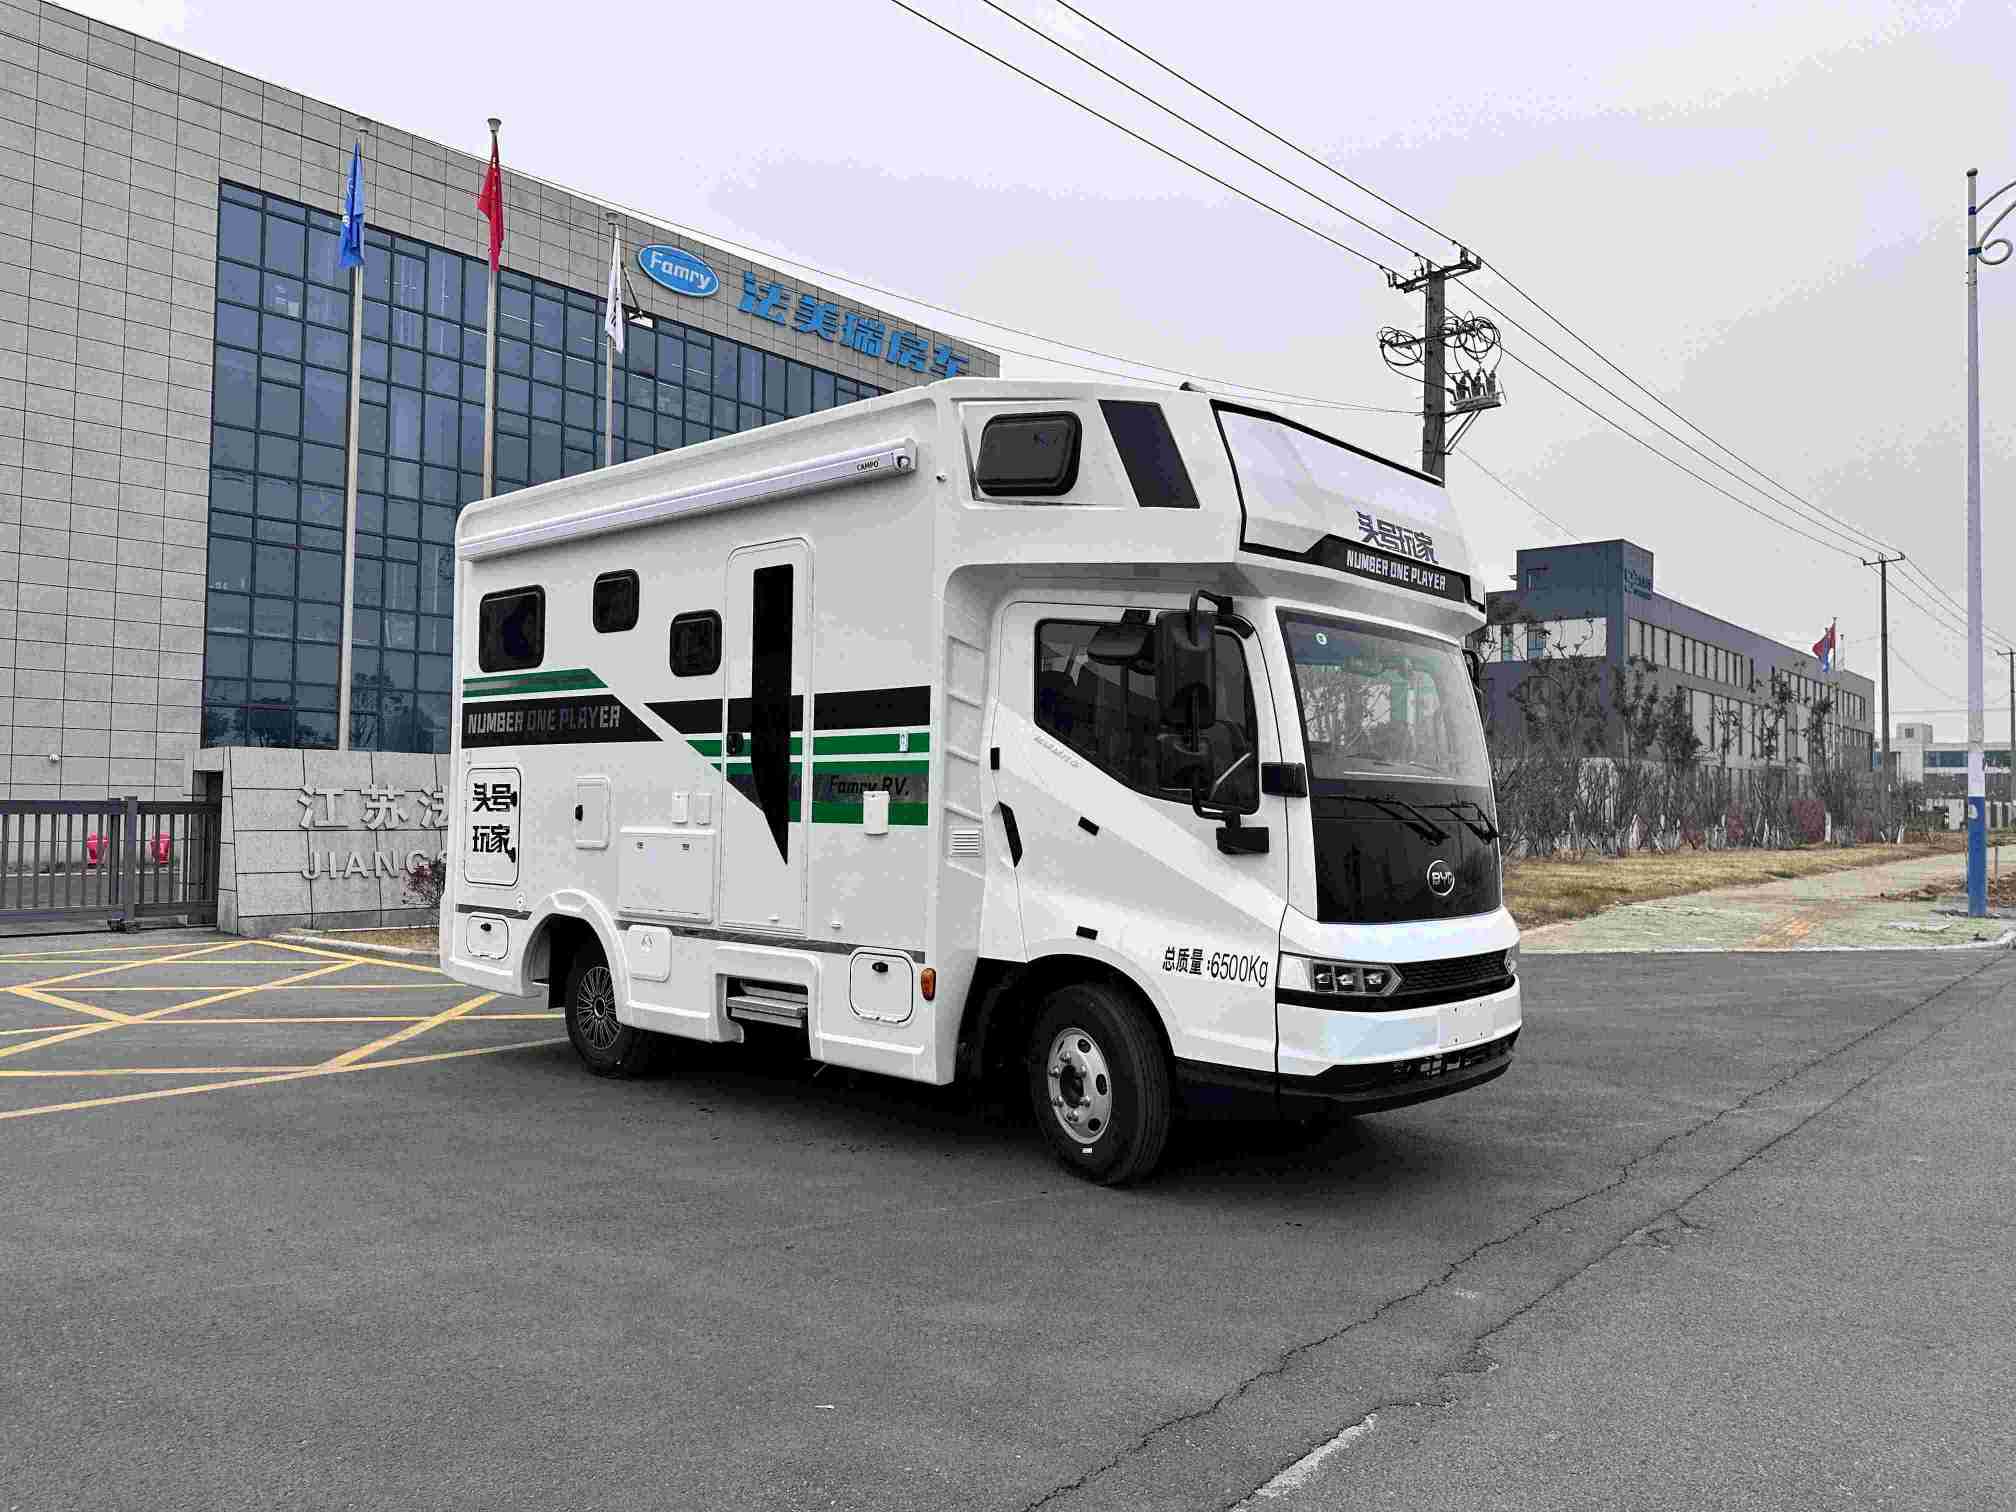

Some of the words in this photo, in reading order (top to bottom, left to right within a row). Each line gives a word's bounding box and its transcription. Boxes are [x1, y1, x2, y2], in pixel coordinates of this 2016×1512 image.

[649, 250, 711, 290] Famry
[737, 270, 969, 379] 法美瑞房车
[1346, 550, 1389, 576] NUMBER
[1390, 560, 1409, 581] ONE
[1410, 566, 1446, 591] PLAYER
[467, 711, 524, 734] NUMBER
[526, 708, 555, 731] ONE
[559, 705, 621, 730] PLAYER
[1432, 871, 1452, 886] BYD
